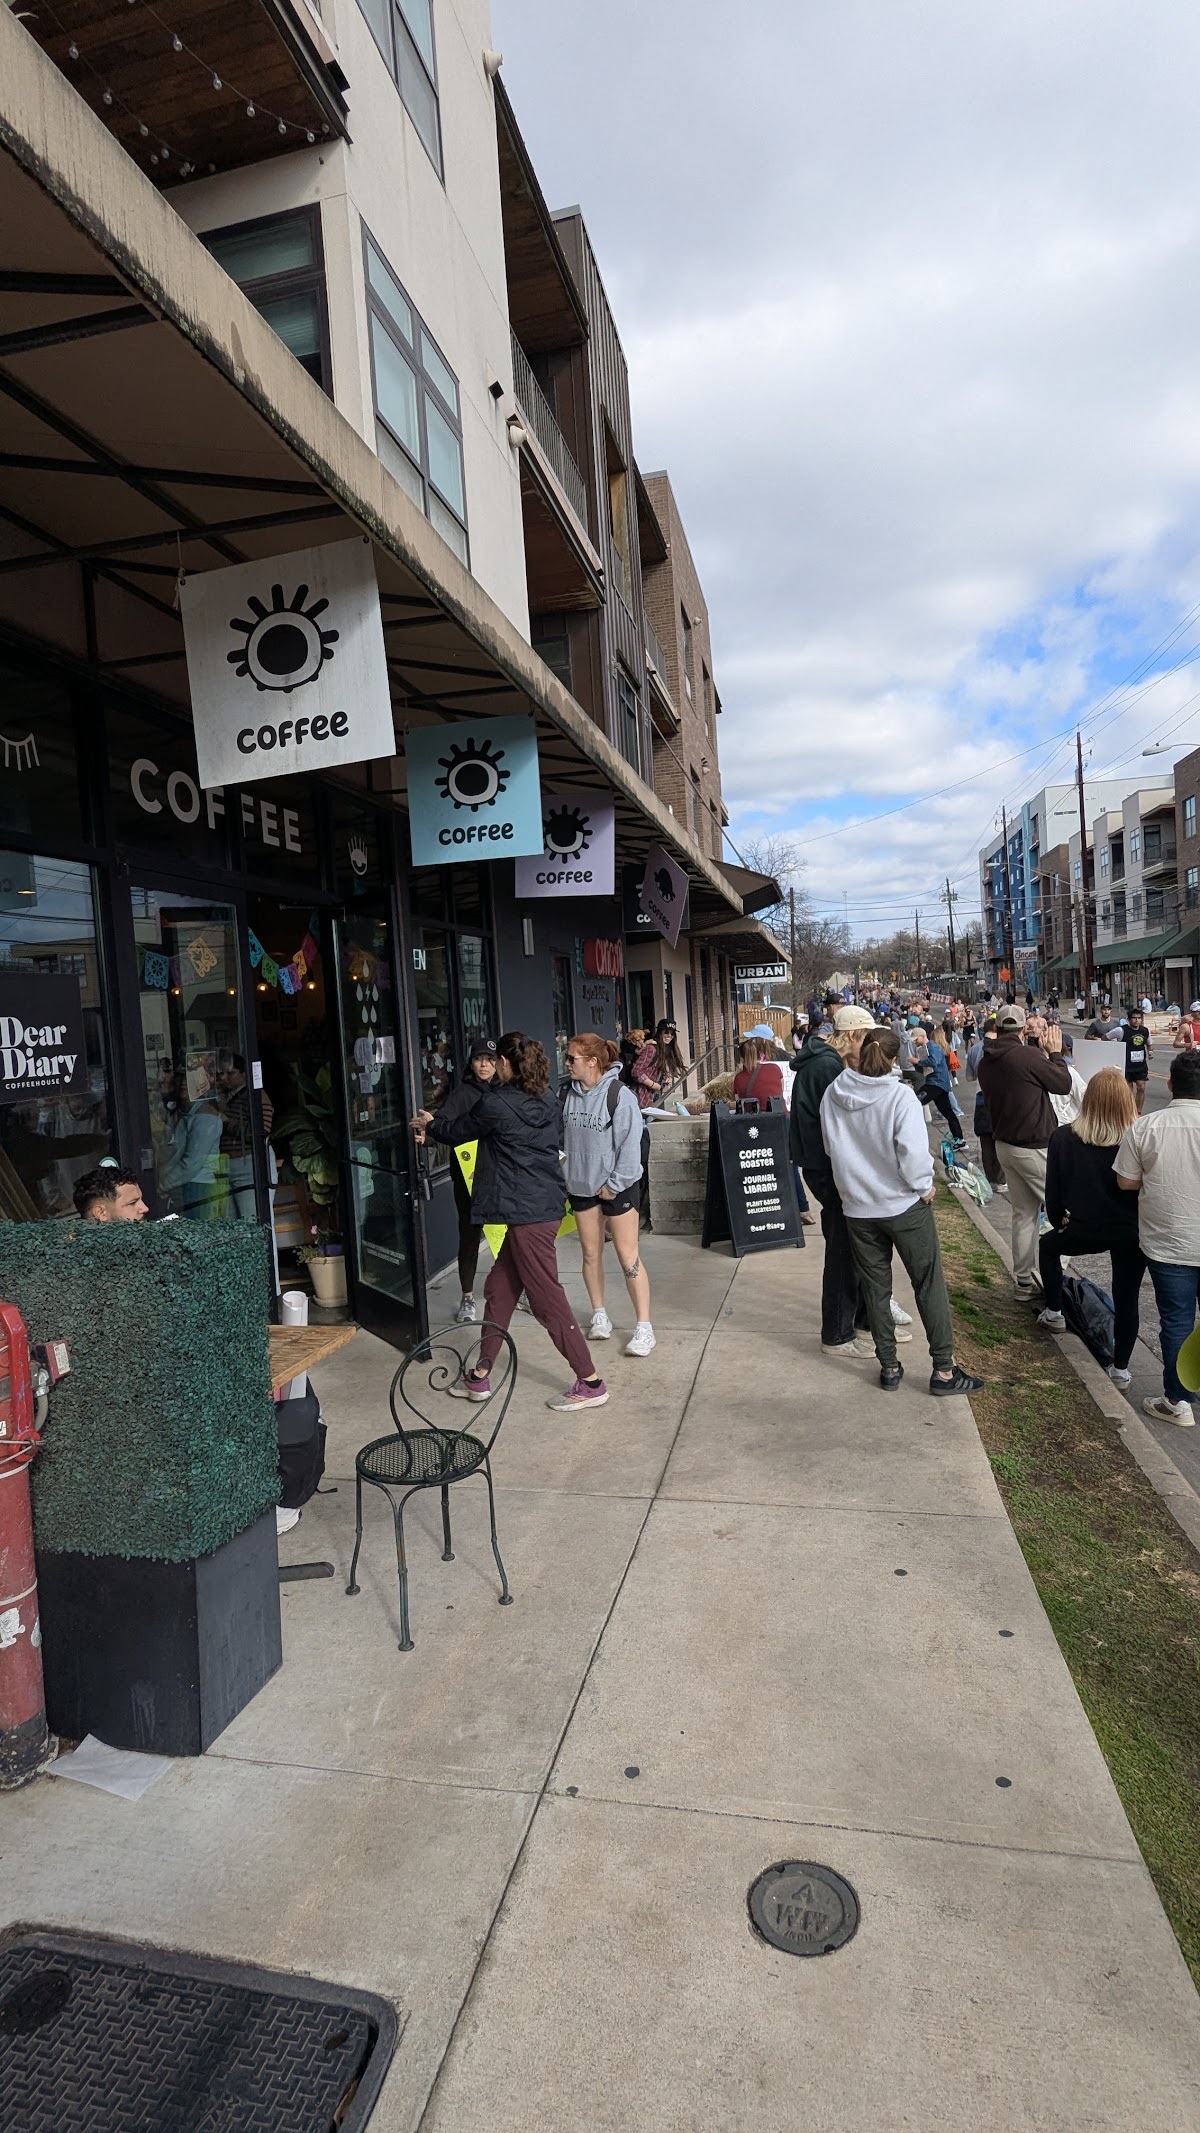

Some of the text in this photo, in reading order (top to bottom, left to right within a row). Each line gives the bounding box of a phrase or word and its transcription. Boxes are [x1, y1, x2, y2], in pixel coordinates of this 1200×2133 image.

[130, 758, 302, 853] COFFEE
[737, 965, 784, 978] URBAN
[0, 1016, 67, 1048] Dear
[0, 1047, 78, 1083] Diary
[5, 1078, 60, 1090] COFFEEHOUSE
